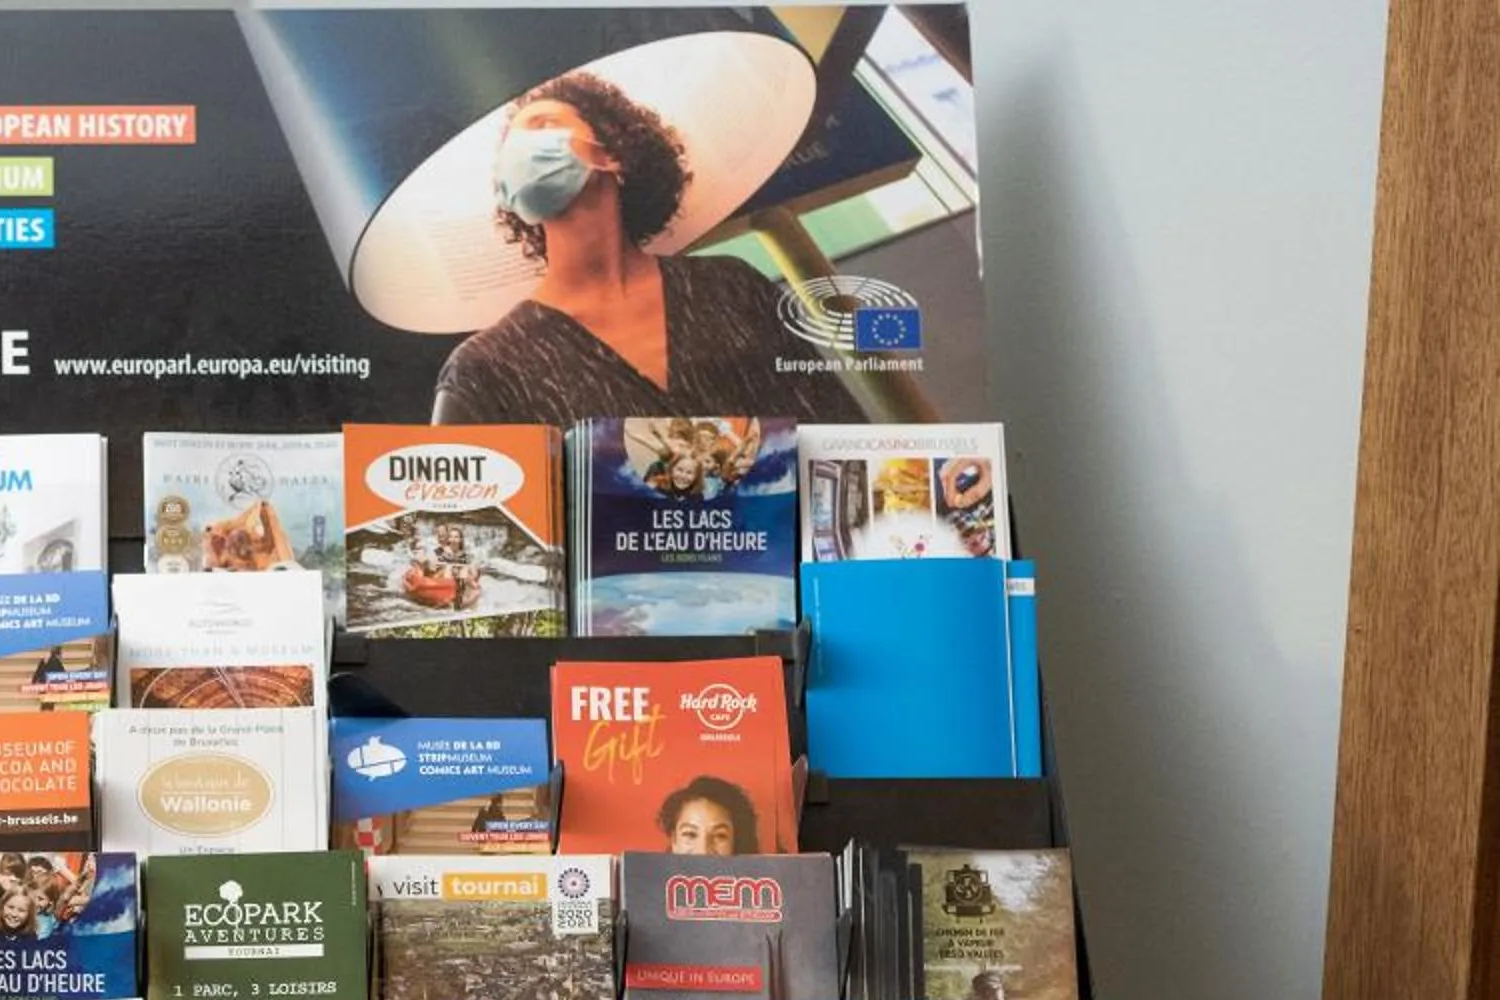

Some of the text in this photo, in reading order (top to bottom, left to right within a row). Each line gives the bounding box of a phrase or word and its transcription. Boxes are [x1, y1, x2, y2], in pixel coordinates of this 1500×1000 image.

[78, 114, 187, 137] HISTORY
[54, 354, 370, 379] www.europarl.europa.eu/visiting
[776, 357, 924, 372] European Parliament
[389, 456, 486, 482] DINANT
[653, 510, 732, 529] LES LACS
[616, 532, 767, 551] DE L'EAU D'HEURE
[55, 741, 76, 757] OF
[40, 759, 76, 774] AND
[160, 795, 252, 814] Wallonie
[394, 876, 539, 896] visit tournai
[184, 900, 324, 929] ECOPARK
[185, 927, 324, 943] AVENTURES
[228, 947, 282, 957] TOURNAI
[173, 981, 337, 998] 1 PARC, 3 LOISIRS
